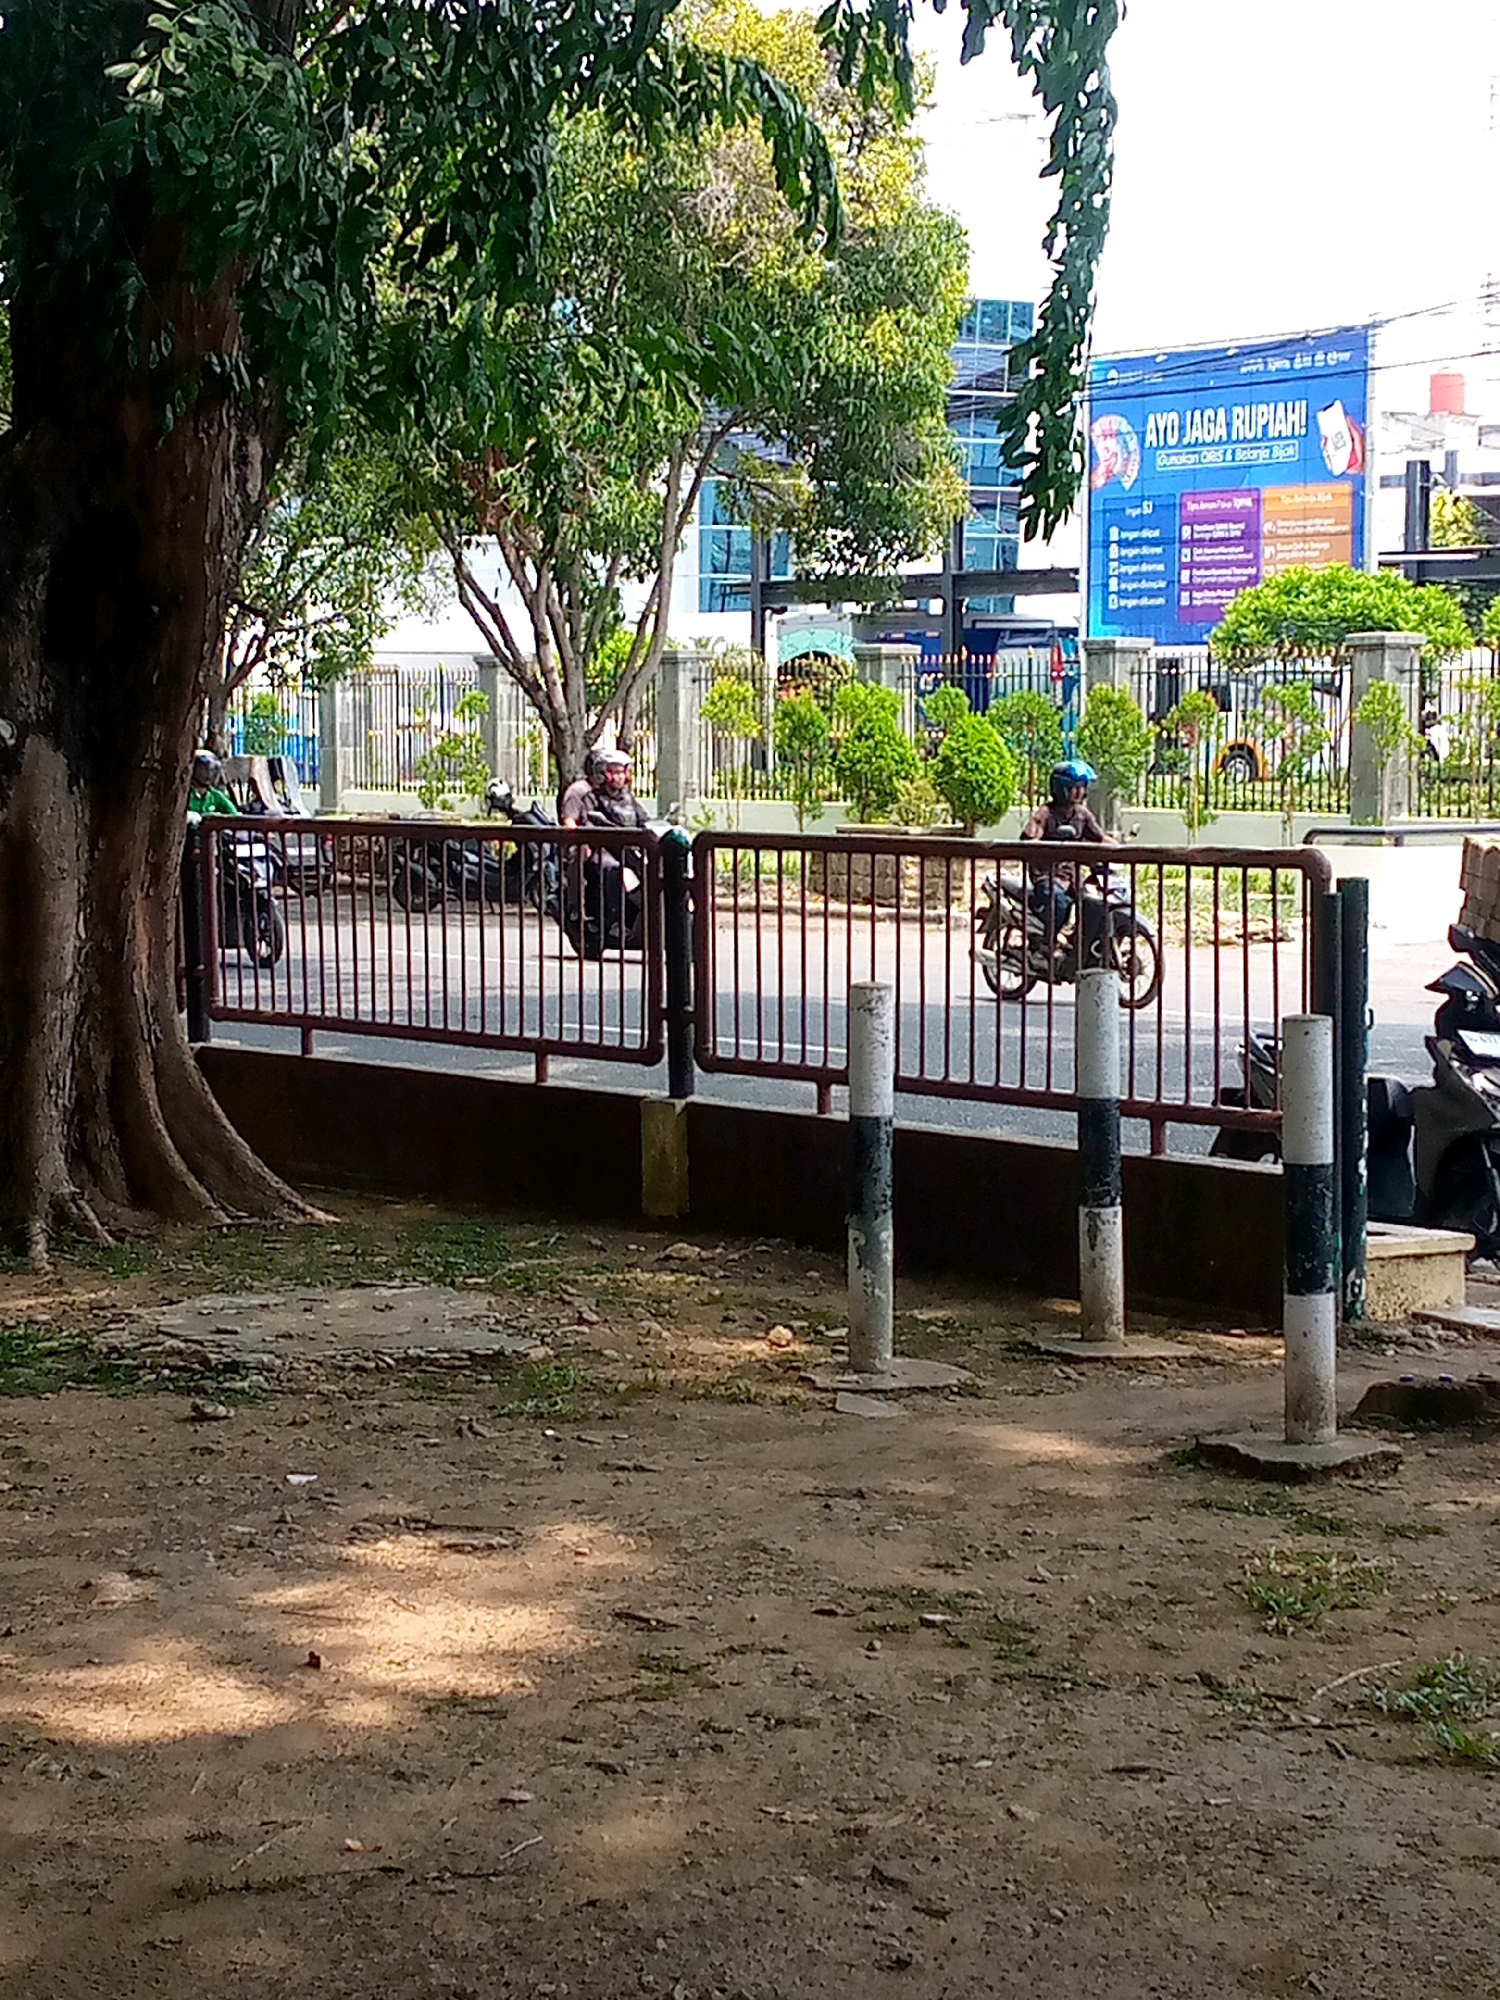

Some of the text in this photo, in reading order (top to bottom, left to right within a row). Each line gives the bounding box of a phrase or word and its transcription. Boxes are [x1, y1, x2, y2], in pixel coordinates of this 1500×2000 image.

[1145, 400, 1307, 448] AYO JAGA RUPIAH!
[1158, 453, 1199, 466] Gunakan
[1235, 447, 1270, 461] Belanja
